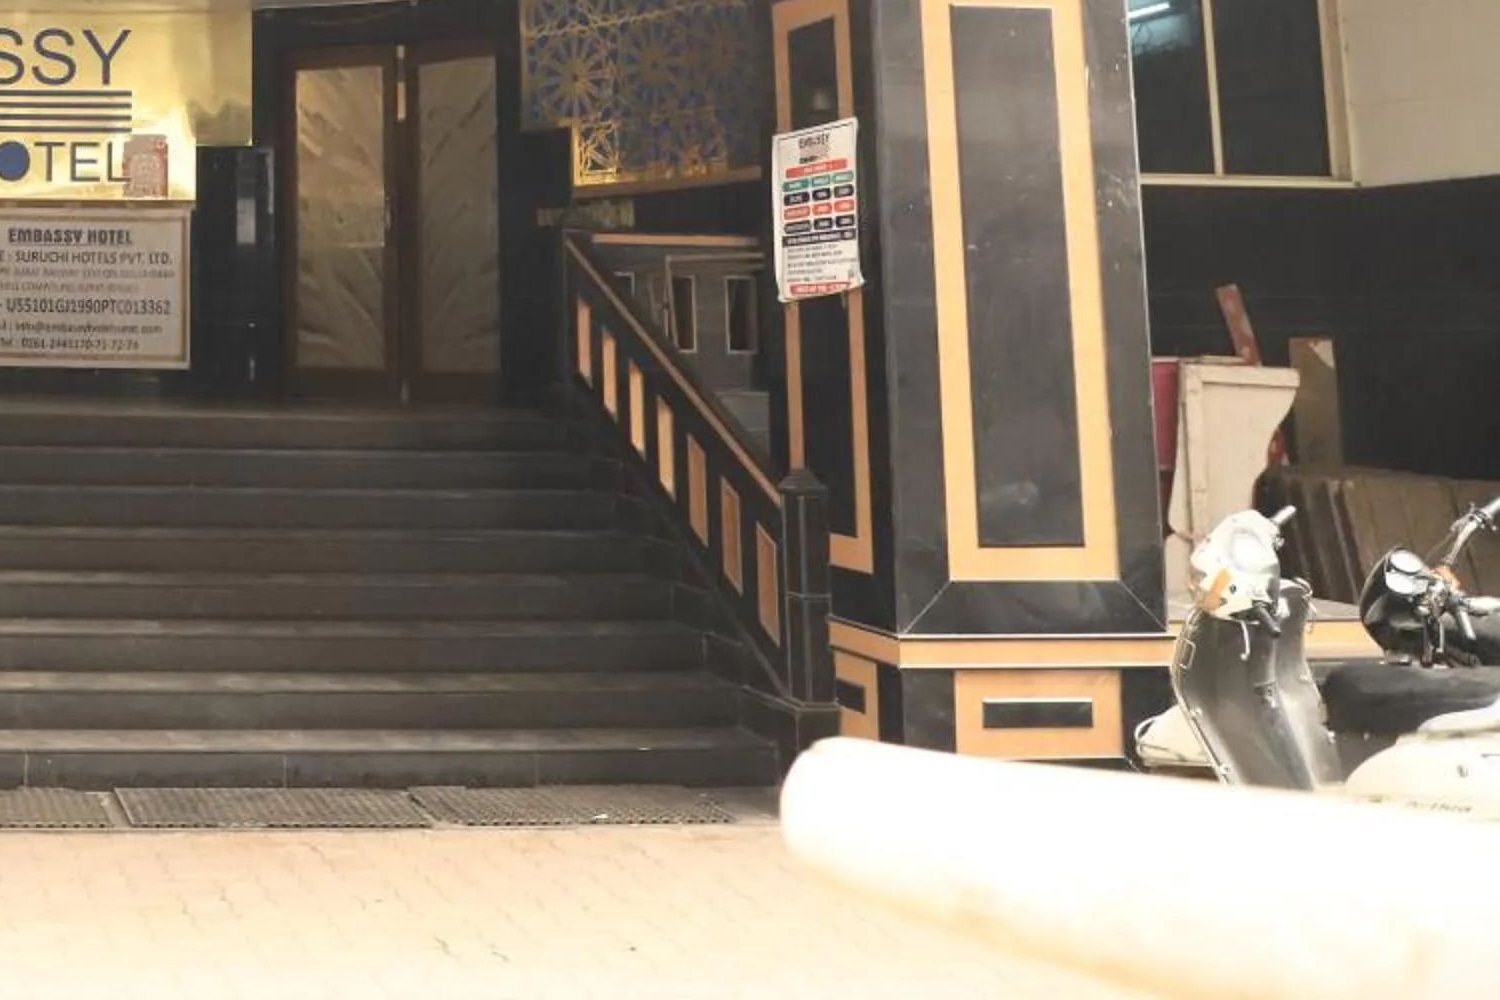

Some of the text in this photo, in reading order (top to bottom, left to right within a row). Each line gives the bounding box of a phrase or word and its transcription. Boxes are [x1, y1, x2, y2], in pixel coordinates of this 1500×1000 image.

[7, 227, 133, 245] EMBASSY HOTEL
[14, 250, 70, 264] SURUCHI
[71, 252, 117, 265] HOTELS
